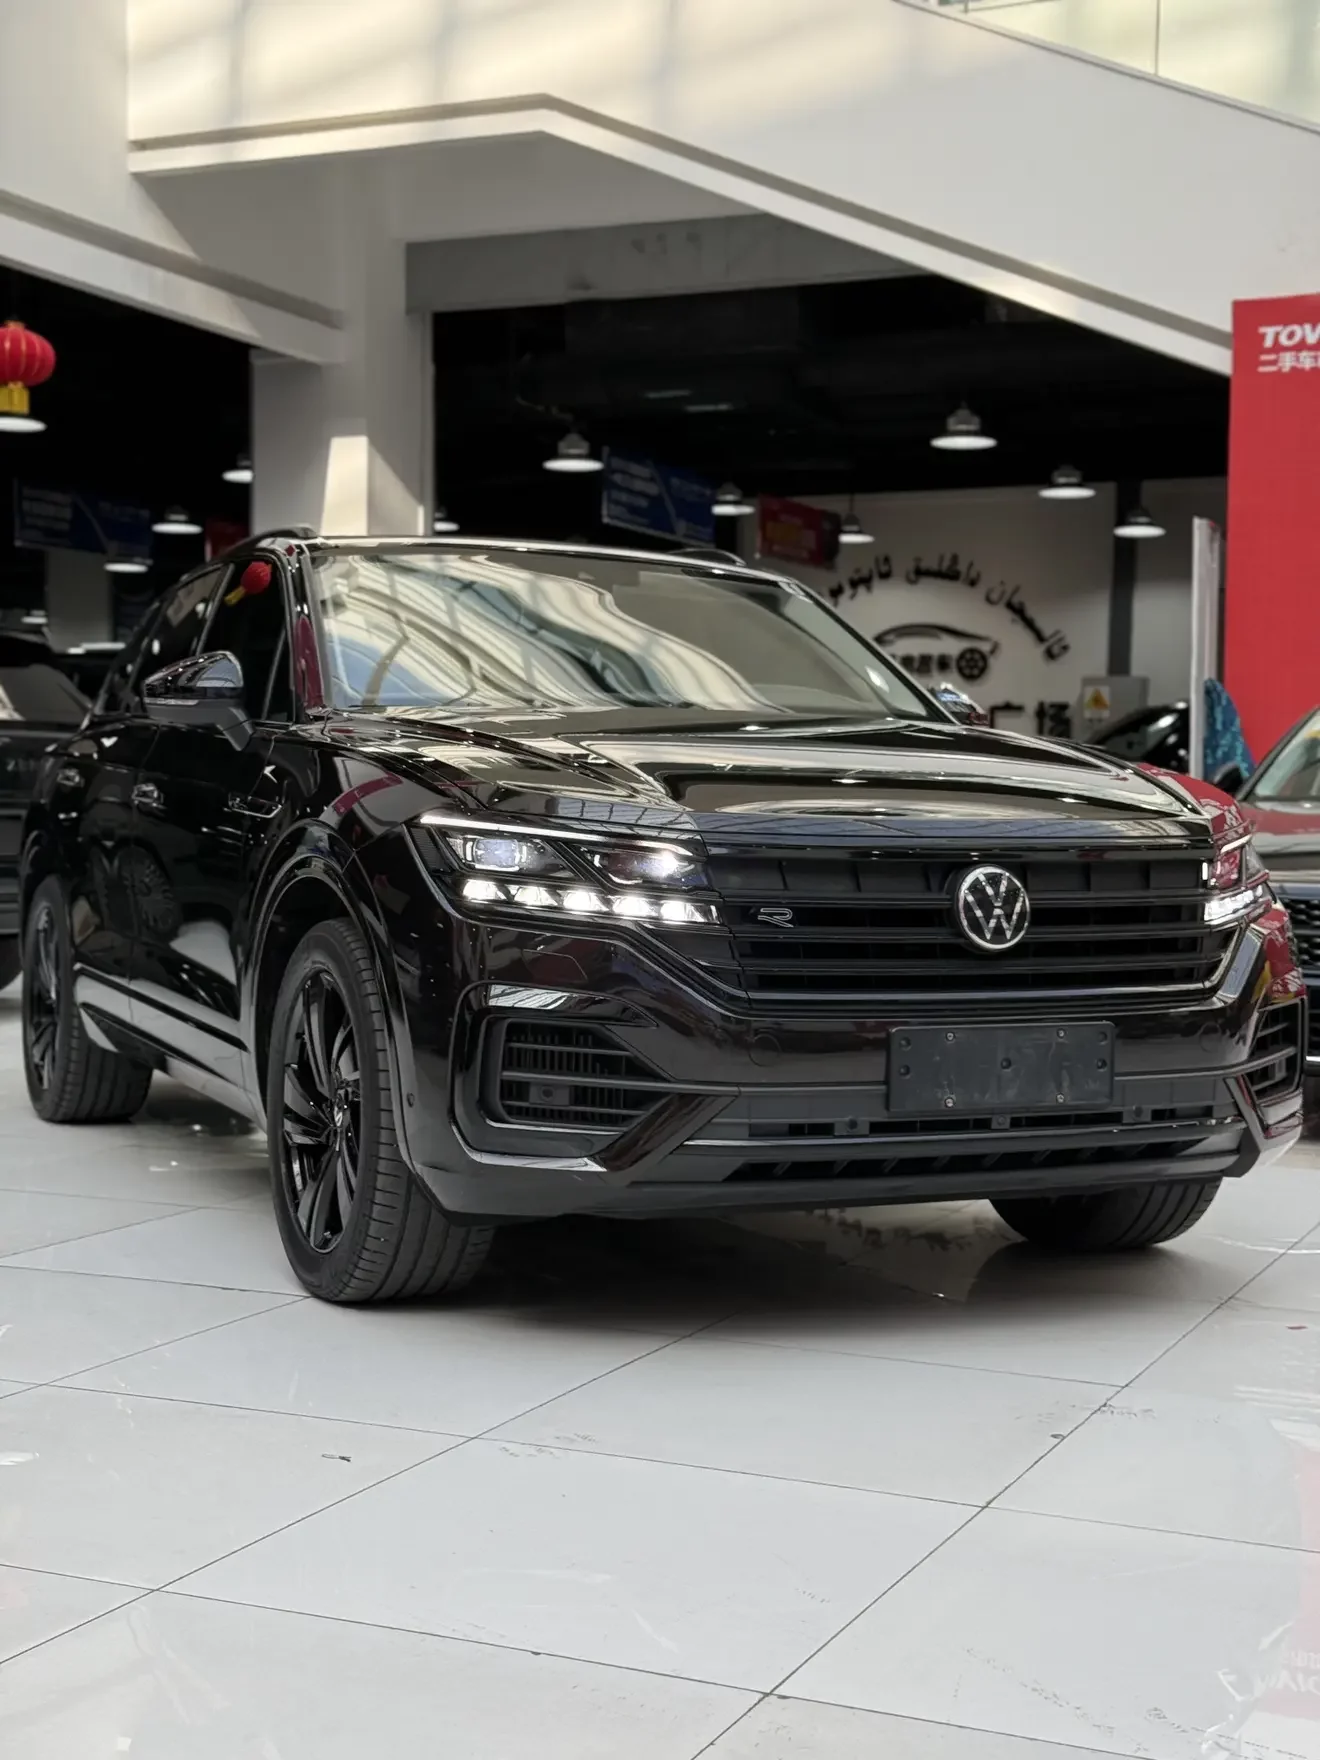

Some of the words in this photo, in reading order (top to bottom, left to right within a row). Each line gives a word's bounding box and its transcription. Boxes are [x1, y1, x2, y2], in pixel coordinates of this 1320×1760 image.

[1257, 350, 1320, 372] 二手车
[758, 908, 794, 928] R
